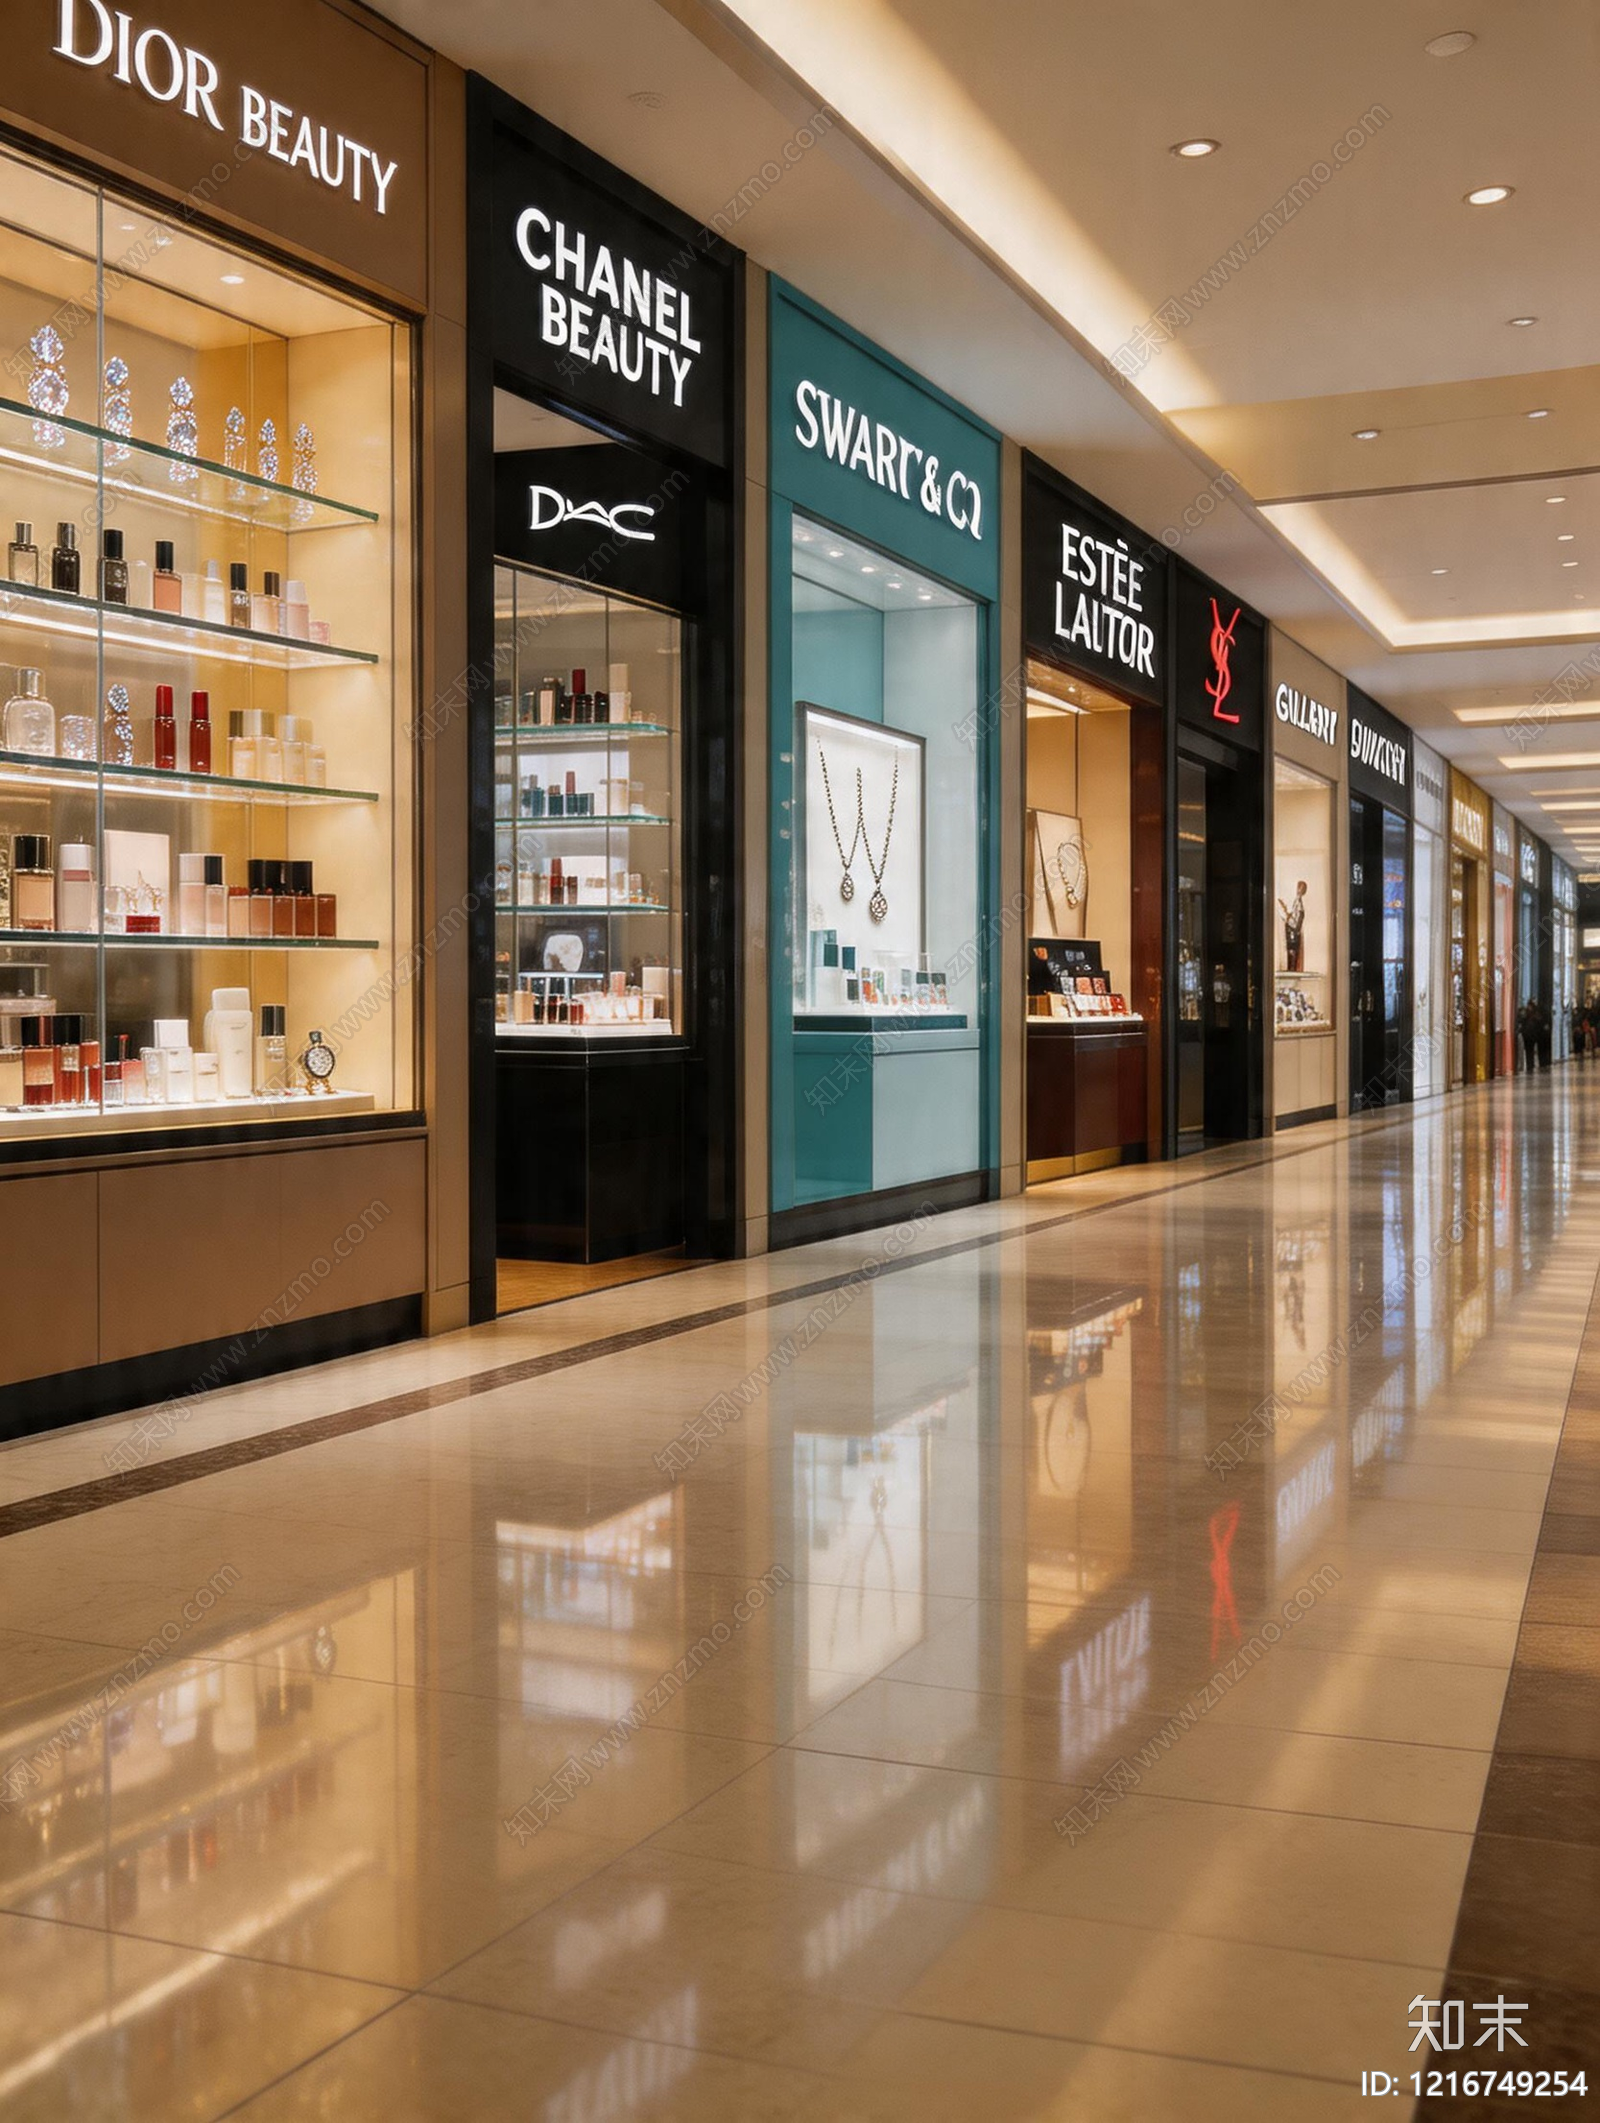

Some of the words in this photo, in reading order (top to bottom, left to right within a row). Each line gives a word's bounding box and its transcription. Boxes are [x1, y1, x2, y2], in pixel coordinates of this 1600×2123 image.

[53, 0, 224, 131] DIOR
[241, 85, 397, 214] BEAUTY
[516, 207, 701, 354] CHANEL
[541, 283, 692, 407] BEAUTY
